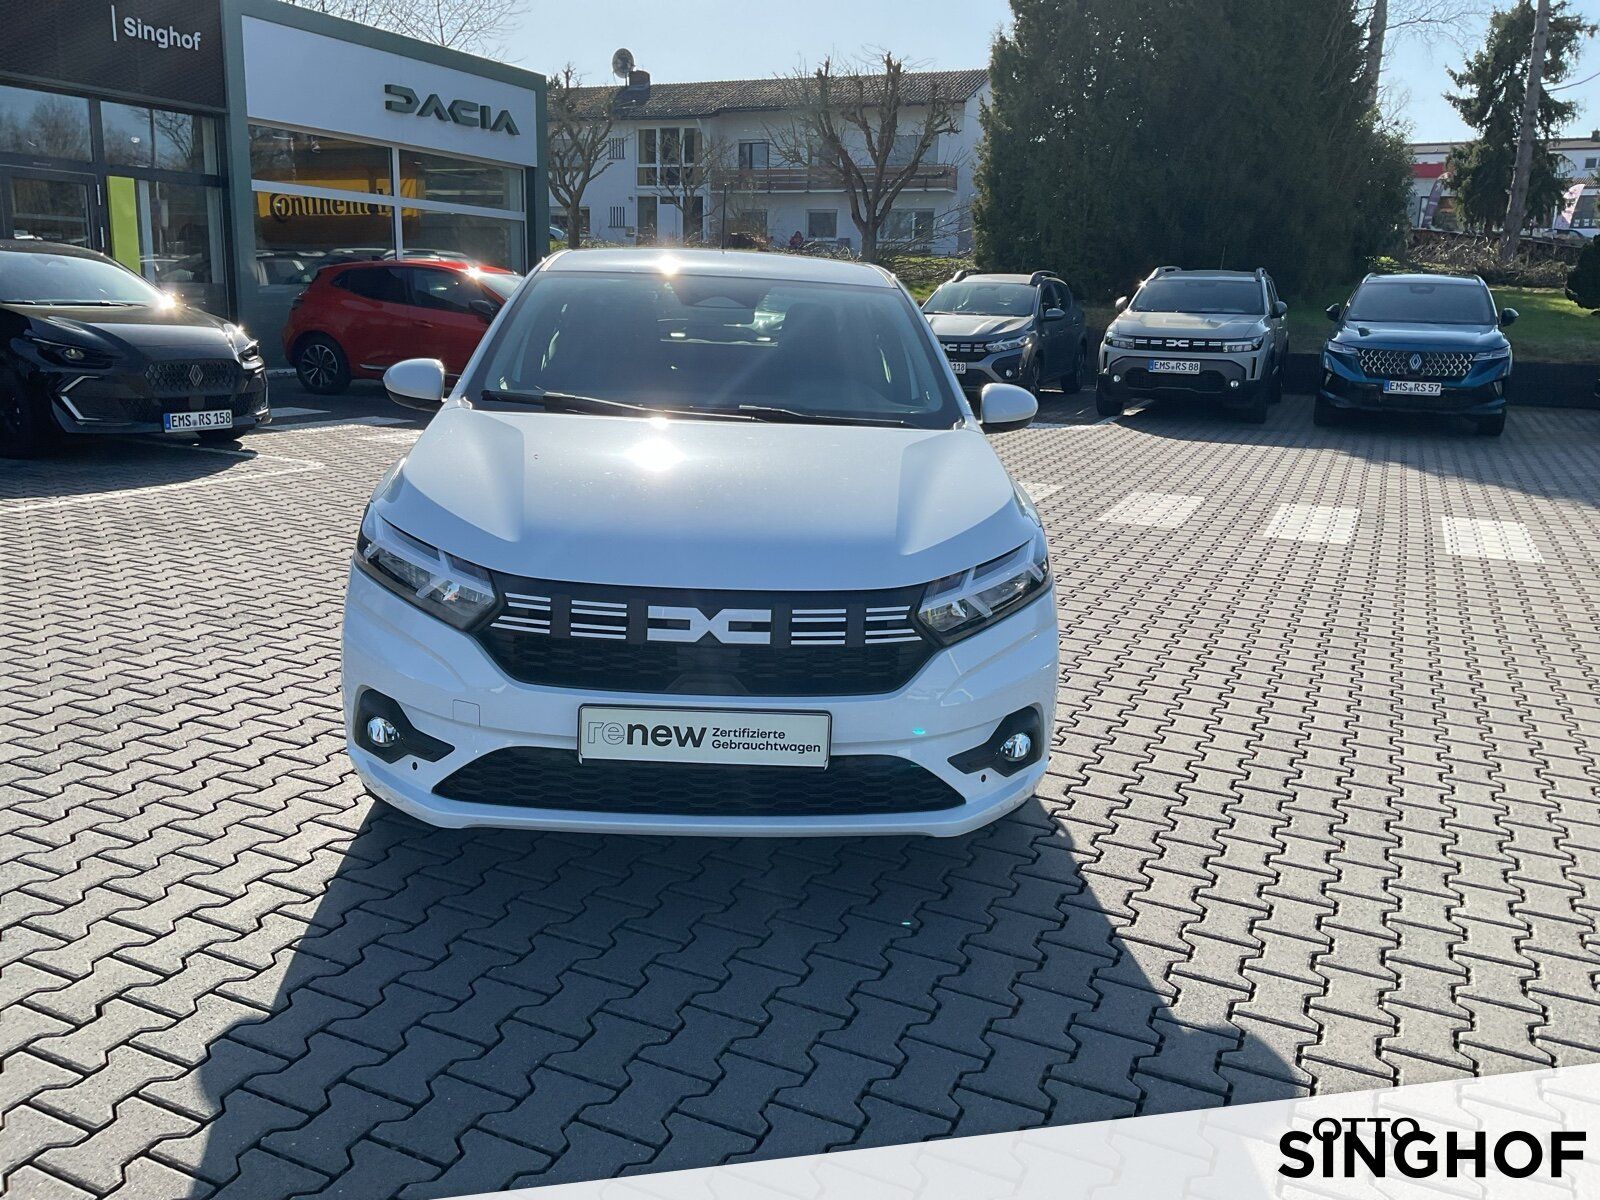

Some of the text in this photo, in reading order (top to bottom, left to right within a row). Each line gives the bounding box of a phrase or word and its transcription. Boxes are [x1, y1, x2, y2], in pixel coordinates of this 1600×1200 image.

[123, 16, 201, 51] Singhof
[384, 83, 521, 136] DACIA
[1154, 361, 1199, 371] EMS RS 88
[1390, 381, 1441, 393] EMS RS 57
[171, 411, 231, 428] EMS RS 158
[587, 721, 707, 748] renew
[712, 727, 786, 740] Zertifizierte
[711, 739, 821, 754] Gebrauchtwagen
